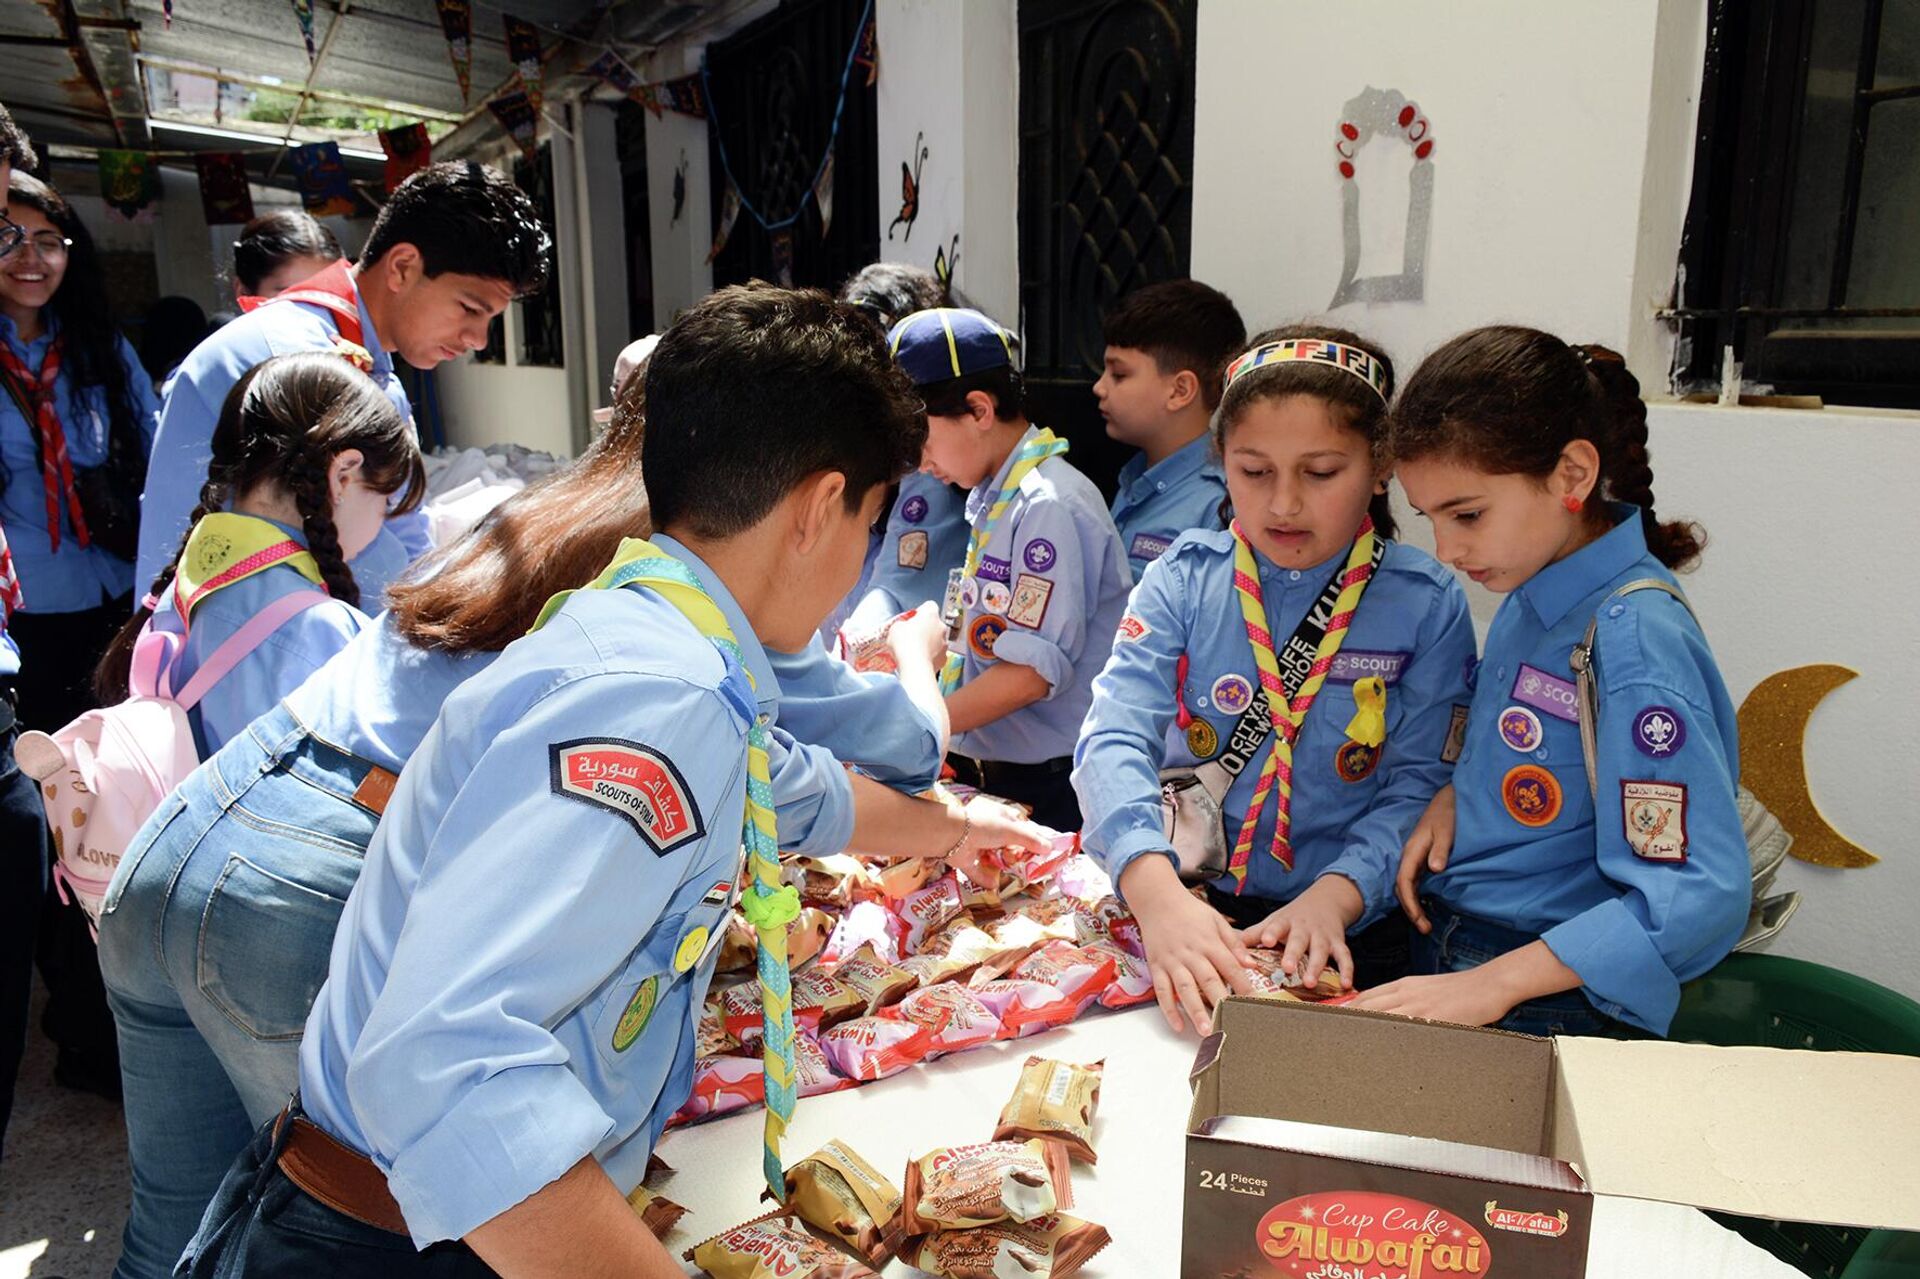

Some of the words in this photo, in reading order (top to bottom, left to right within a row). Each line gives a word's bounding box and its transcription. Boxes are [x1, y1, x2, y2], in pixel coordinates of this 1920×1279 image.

[1142, 540, 1169, 554] SCOUT
[981, 560, 1011, 576] COUTS
[1350, 657, 1400, 671] SCOUT
[578, 756, 639, 779] سورية
[595, 782, 631, 805] SCOUTS
[630, 797, 643, 811] OF
[1200, 1170, 1228, 1190] 24
[1230, 1173, 1268, 1187] Pieces
[1322, 1203, 1374, 1237] Cup
[1382, 1207, 1450, 1237] Cake
[717, 1231, 797, 1277] Alwafai
[1264, 1221, 1481, 1279] Alwafai
